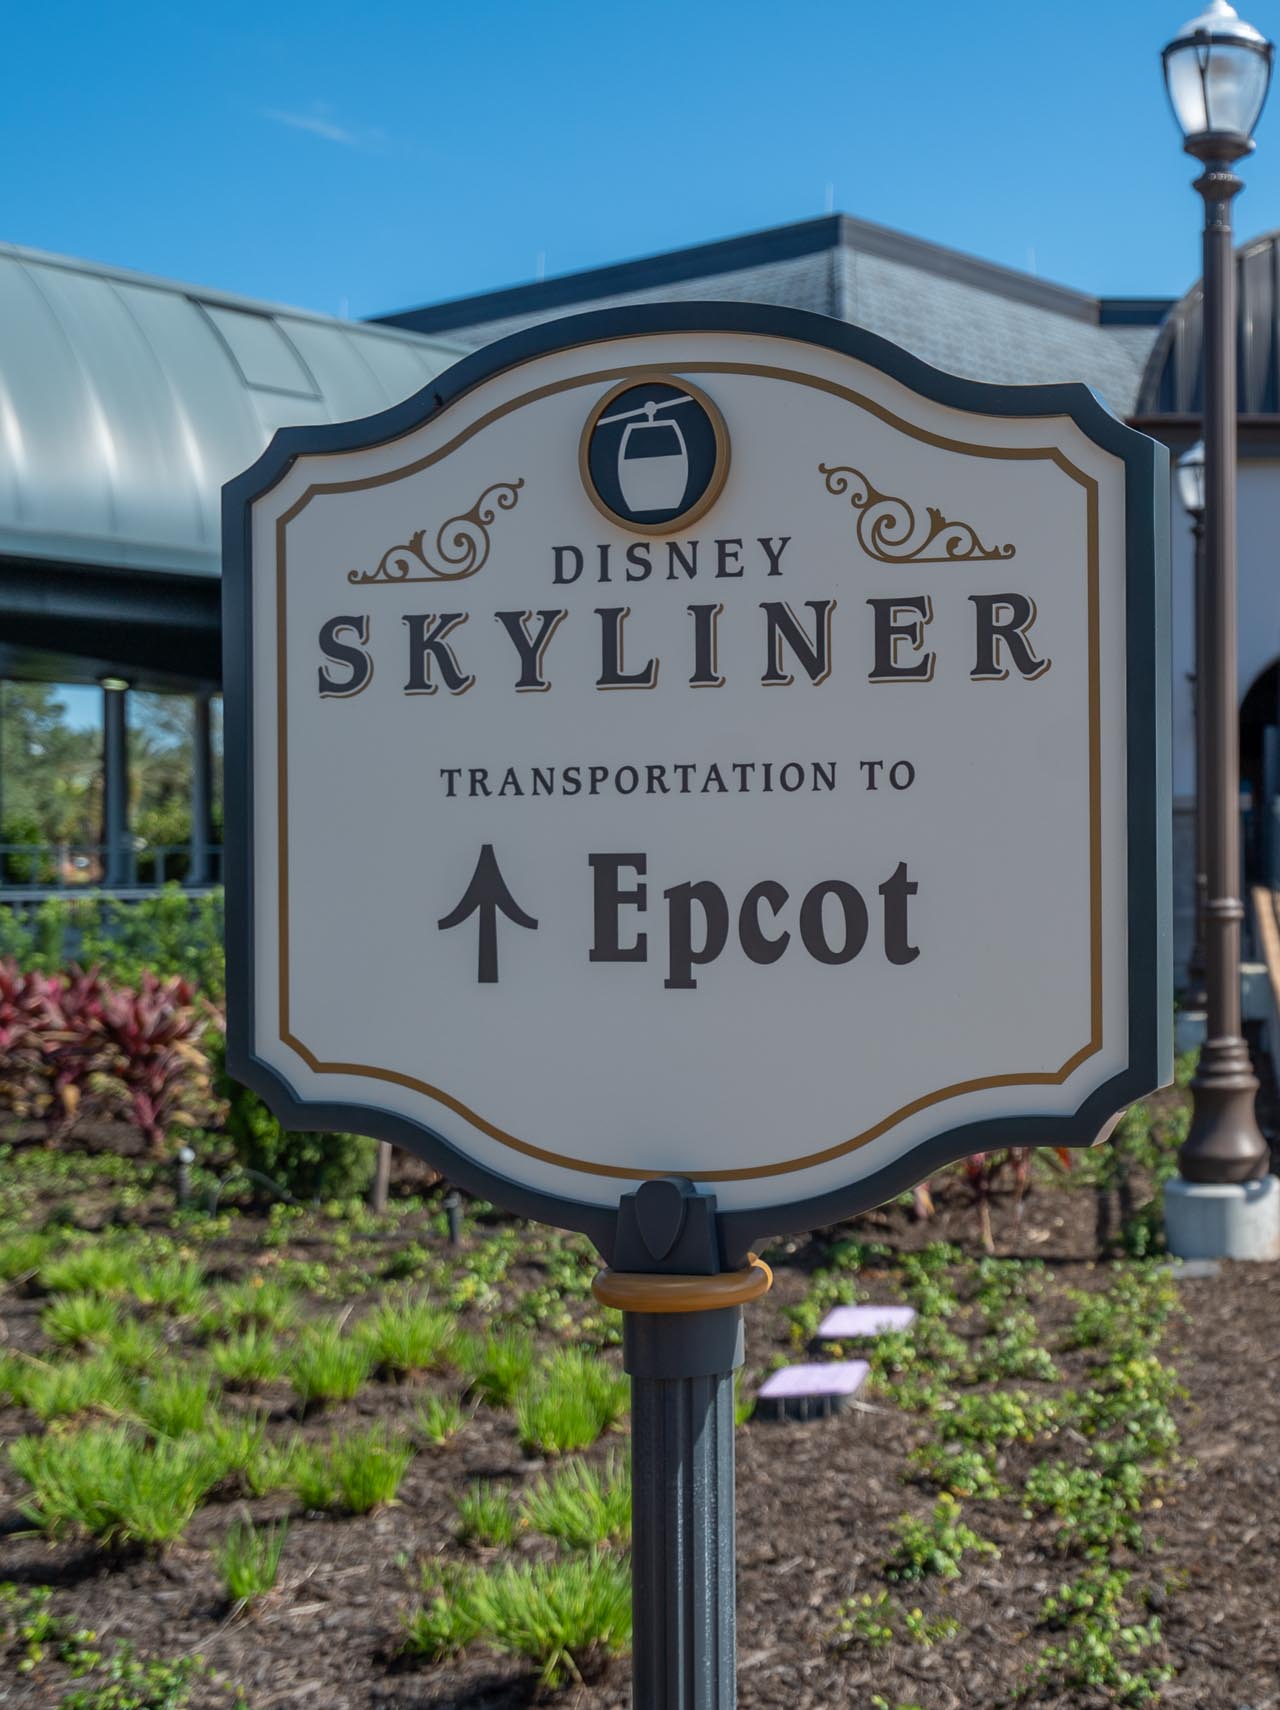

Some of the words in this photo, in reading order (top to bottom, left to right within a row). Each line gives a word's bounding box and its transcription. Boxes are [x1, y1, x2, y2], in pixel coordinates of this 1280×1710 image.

[551, 535, 793, 585] DISNEY
[317, 591, 1051, 698] SKYLINER
[440, 761, 838, 798] TRANSPORTATION
[859, 759, 917, 792] TO
[588, 851, 921, 990] Epcot
